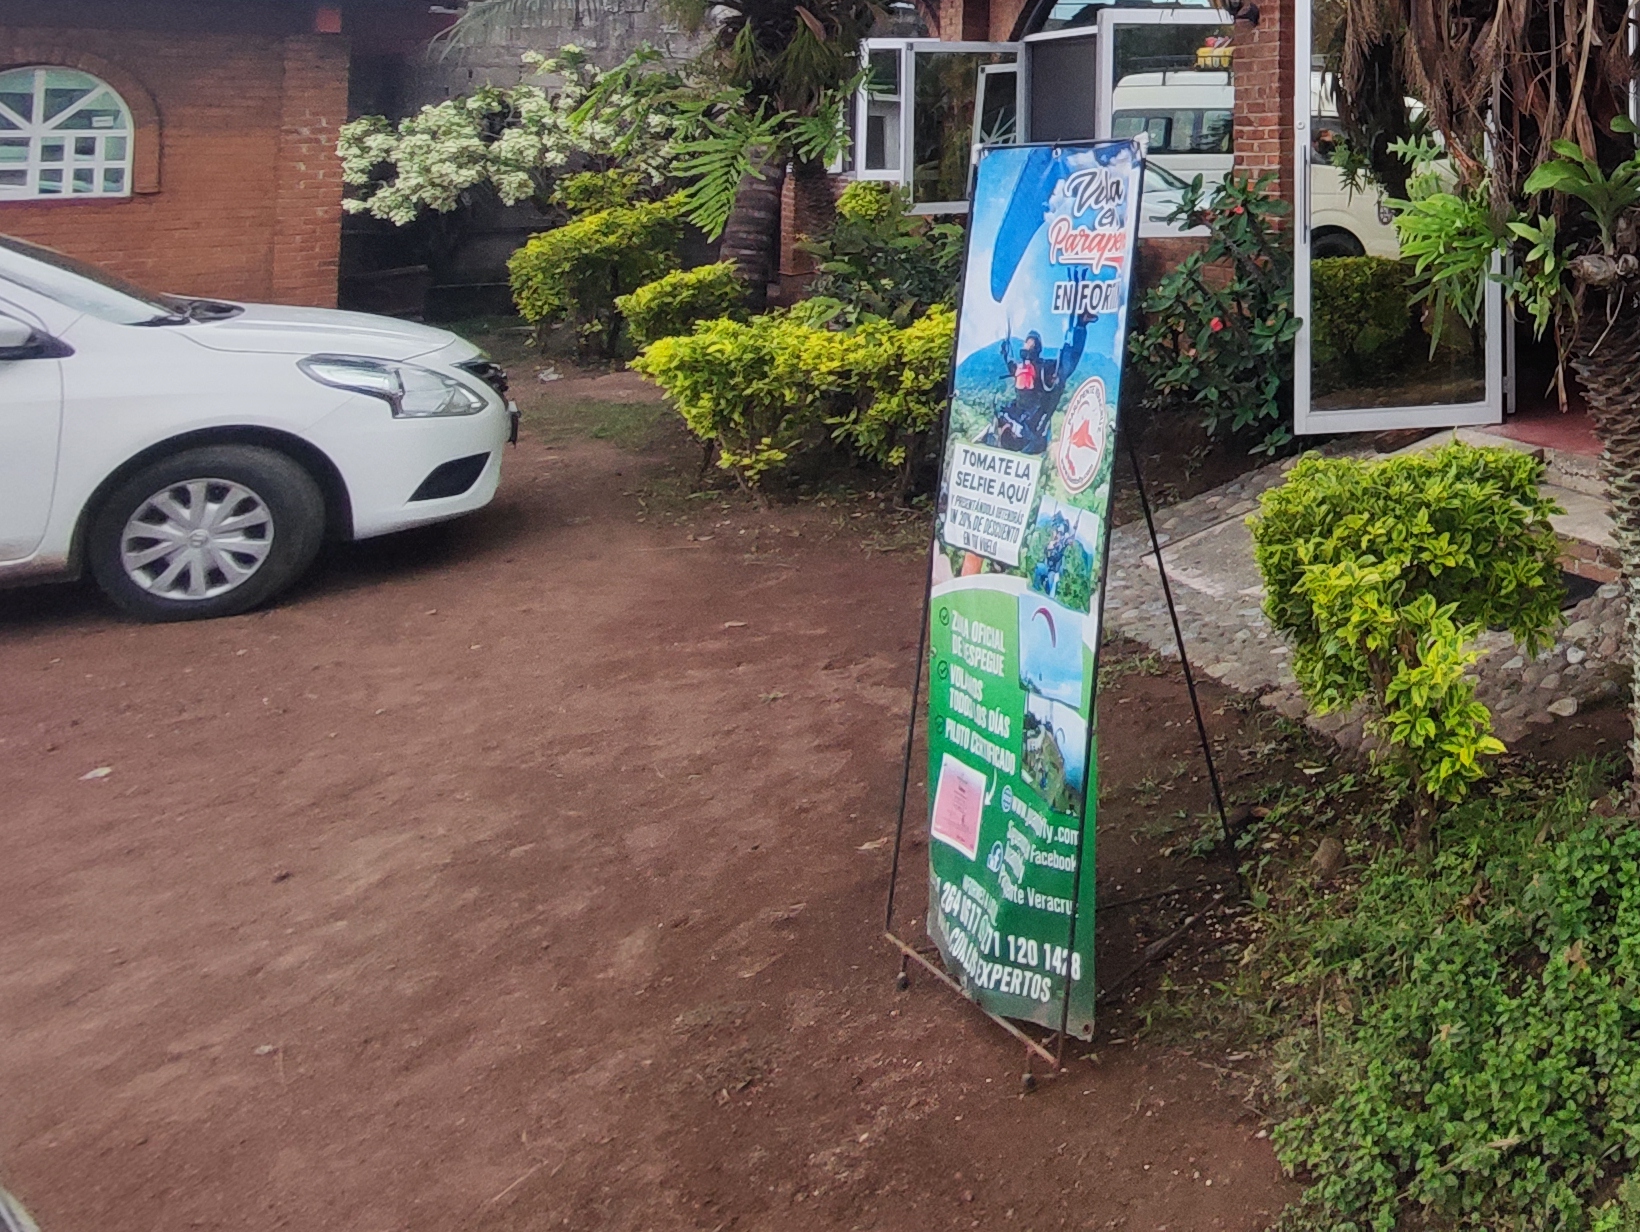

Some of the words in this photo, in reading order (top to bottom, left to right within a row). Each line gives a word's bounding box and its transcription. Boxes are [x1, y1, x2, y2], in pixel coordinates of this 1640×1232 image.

[1053, 283, 1074, 311] EN
[962, 448, 1014, 477] TOMATE
[1014, 461, 1031, 481] LA
[955, 470, 996, 496] SELFIE
[997, 481, 1032, 505] AQUÍ
[972, 514, 985, 532] DE
[971, 620, 1006, 654] OFICIAL
[987, 705, 1011, 739] DÍAS
[1029, 842, 1077, 873] Facebook
[1026, 885, 1079, 919] Veracru
[1007, 934, 1038, 967] 120
[975, 958, 1052, 1003] EXPERTOS
